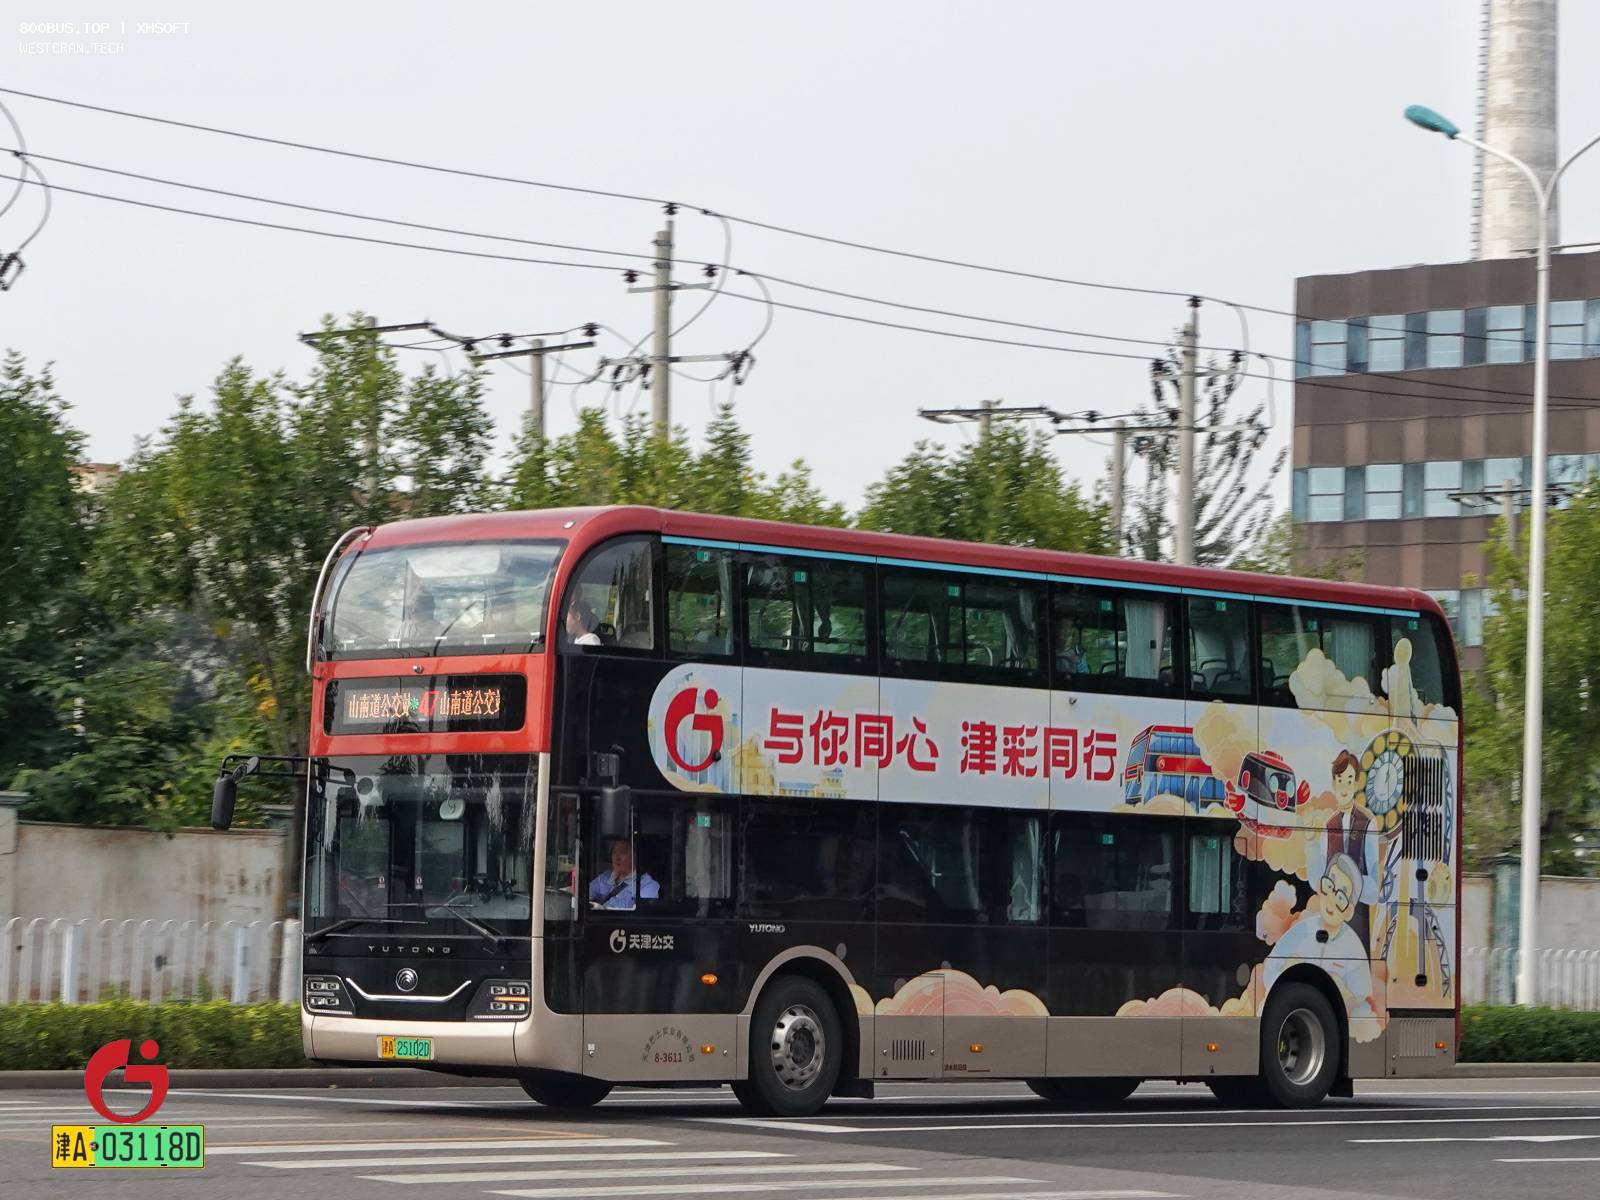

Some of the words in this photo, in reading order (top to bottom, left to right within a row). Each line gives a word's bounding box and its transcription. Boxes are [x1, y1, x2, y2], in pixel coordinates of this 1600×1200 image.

[417, 690, 441, 717] 47
[764, 707, 939, 772] 与你同心
[960, 721, 1117, 781] 津彩同行
[748, 924, 786, 933] YUTONG
[368, 944, 451, 954] YUTONG
[629, 934, 675, 951] 天津公交
[654, 1052, 683, 1063] 8-3611
